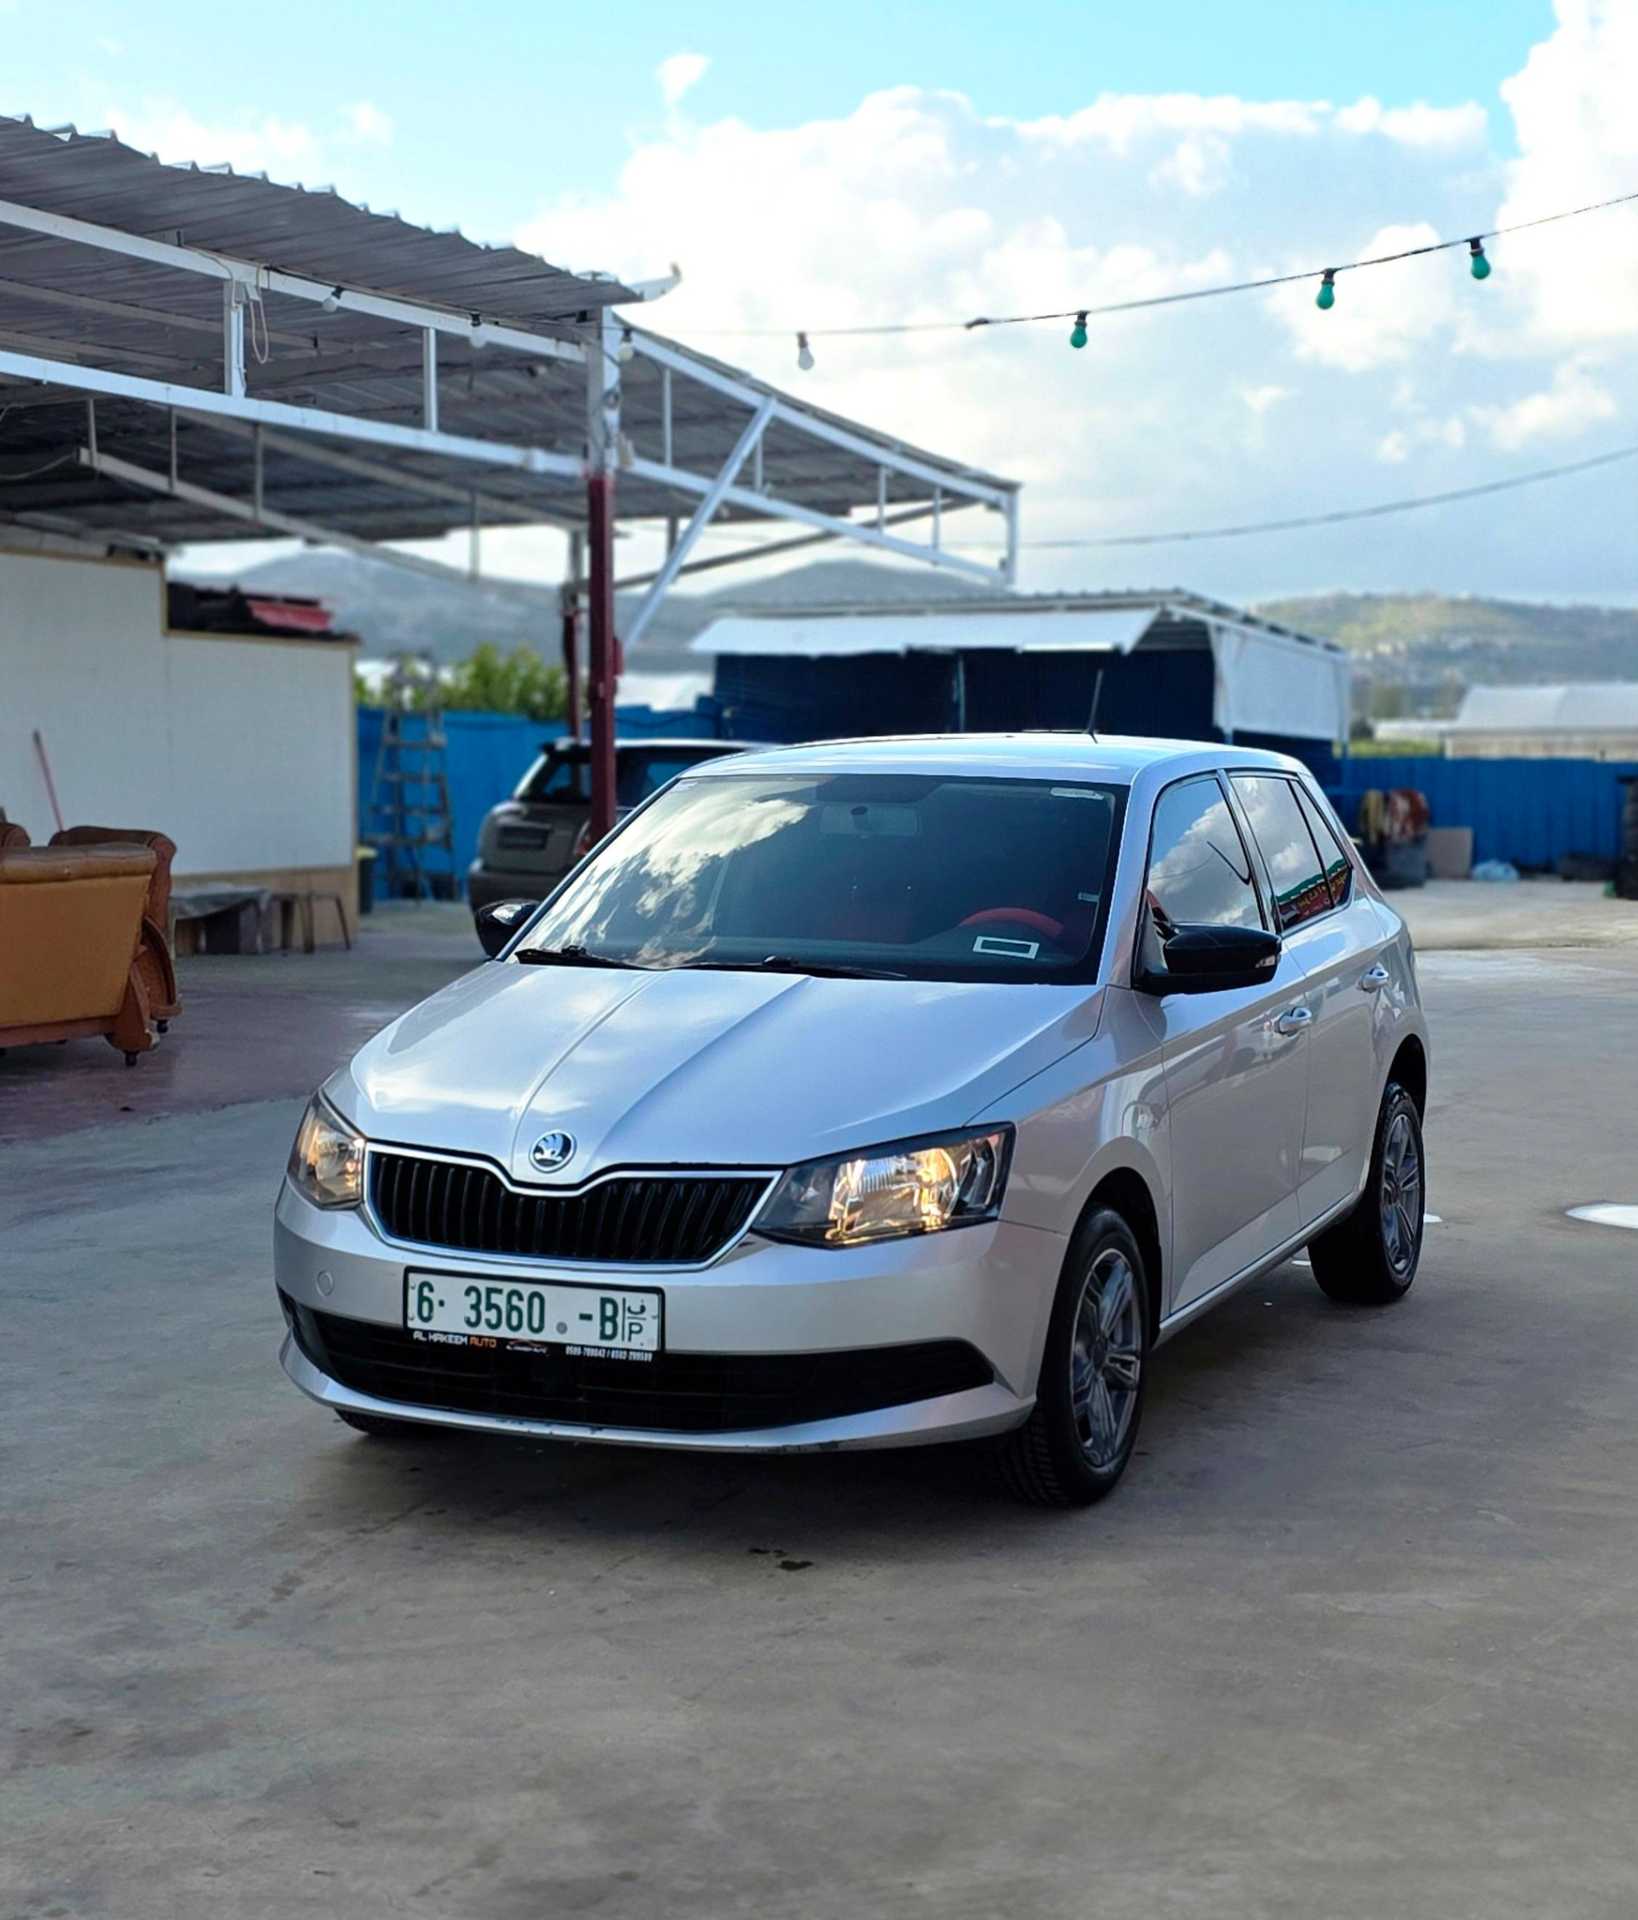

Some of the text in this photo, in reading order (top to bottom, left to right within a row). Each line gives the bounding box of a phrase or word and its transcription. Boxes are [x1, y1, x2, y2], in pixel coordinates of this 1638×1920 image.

[463, 1285, 546, 1334] 3560
[469, 1335, 497, 1349] AUTO
[628, 1321, 644, 1342] P
